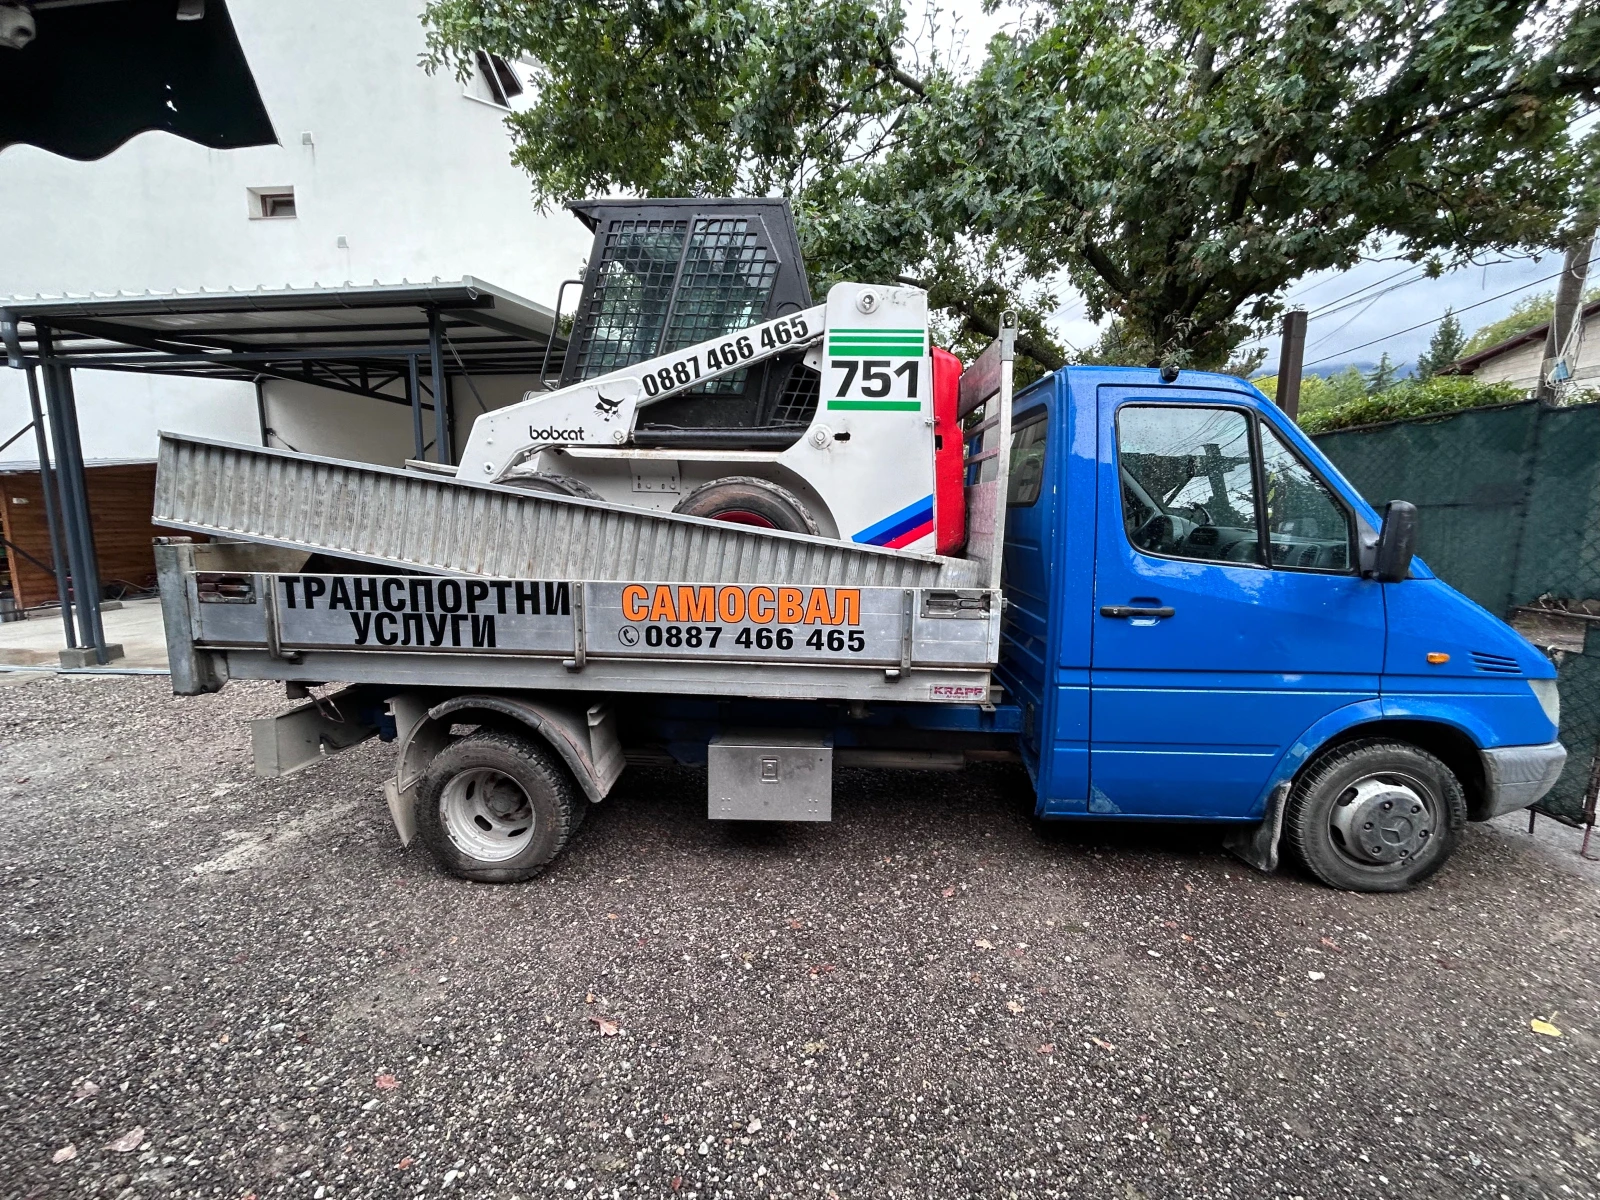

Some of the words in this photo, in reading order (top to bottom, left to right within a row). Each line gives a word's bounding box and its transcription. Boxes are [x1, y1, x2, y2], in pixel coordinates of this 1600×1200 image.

[642, 356, 701, 397] 0887
[706, 335, 754, 371] 466
[760, 313, 809, 350] 465
[830, 360, 919, 398] 751
[529, 425, 584, 441] bobcat
[278, 575, 571, 616] ТРАНСПОРТНИ
[621, 584, 861, 626] САМОСВАЛ
[349, 611, 496, 648] УСЛУГИ
[645, 625, 723, 649] 0887
[734, 626, 794, 650] 466
[805, 629, 865, 652] 465
